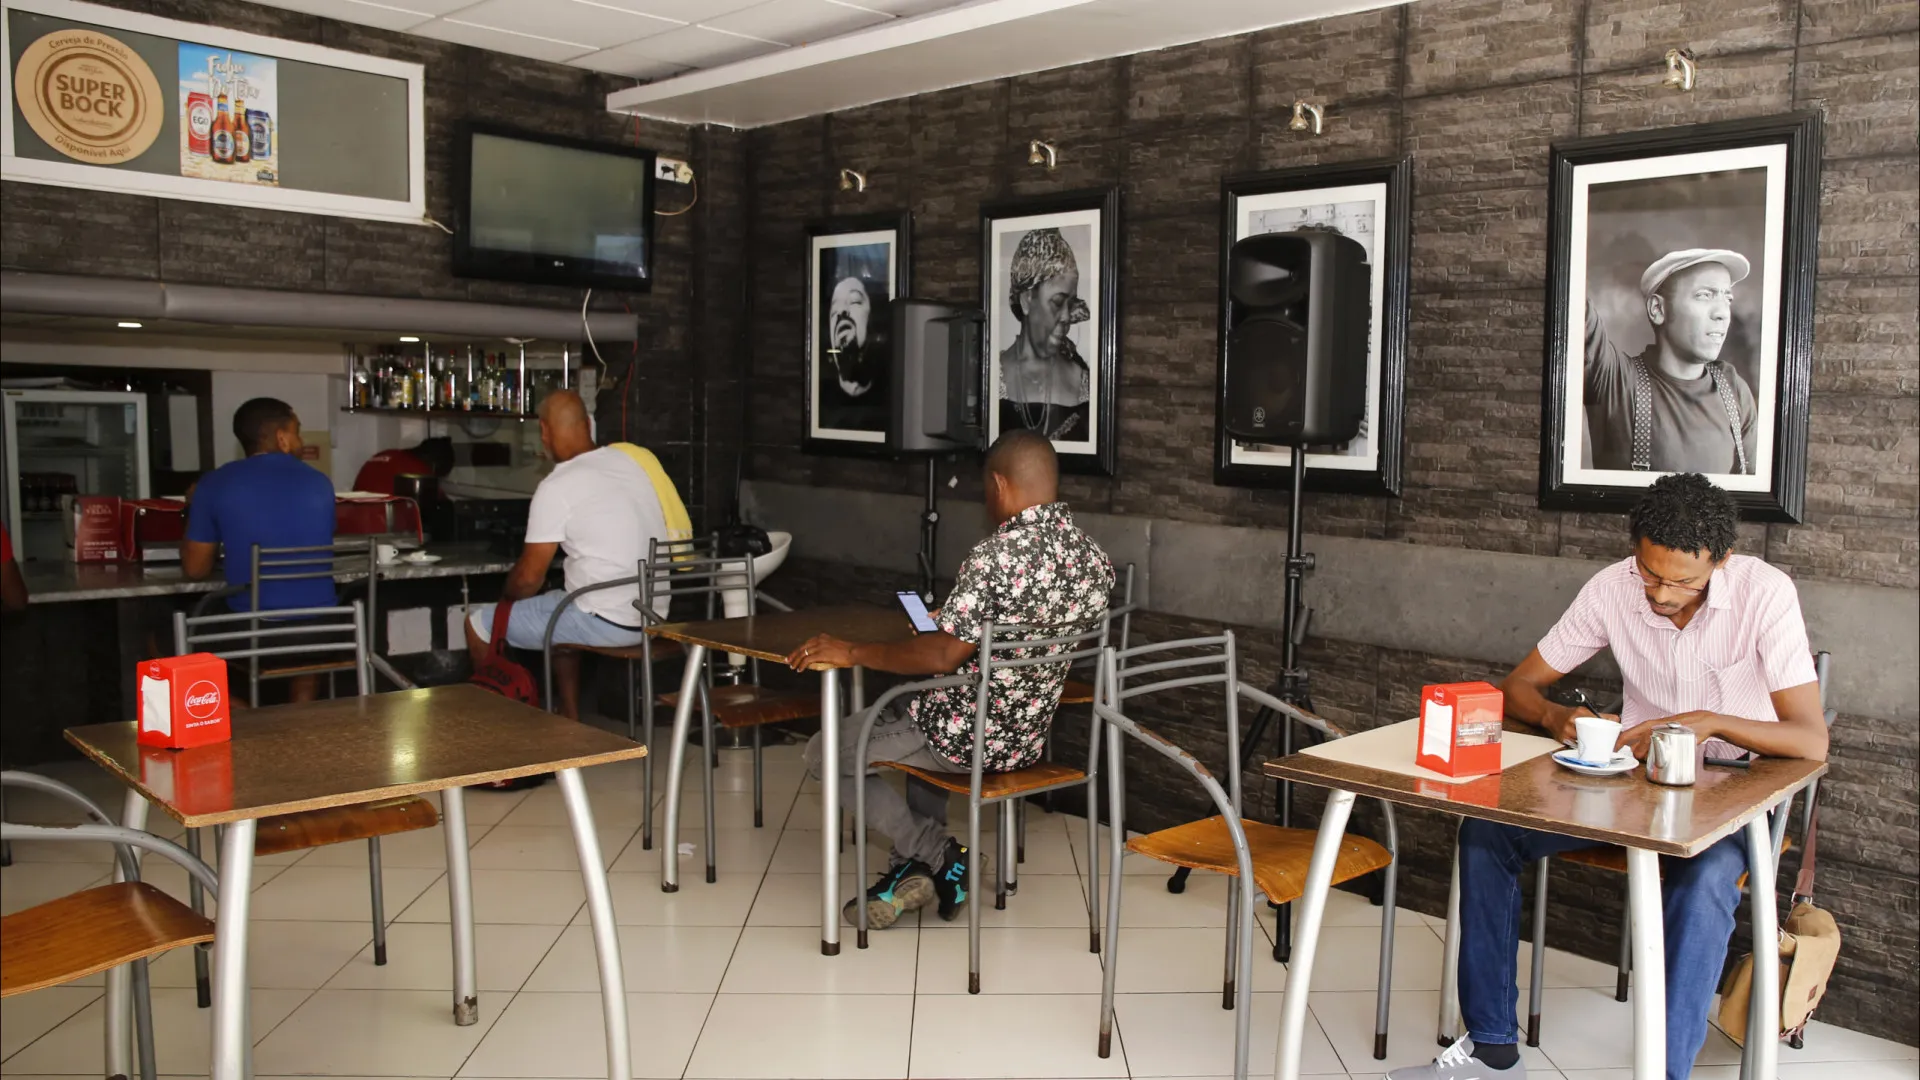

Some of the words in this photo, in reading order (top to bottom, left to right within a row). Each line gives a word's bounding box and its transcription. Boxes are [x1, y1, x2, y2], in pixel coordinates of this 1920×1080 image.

[48, 37, 81, 49] Cerveja
[83, 36, 95, 44] de
[96, 38, 129, 60] Pressão
[56, 74, 126, 101] SUPER
[60, 92, 124, 119] BOCK
[192, 115, 209, 125] EGO
